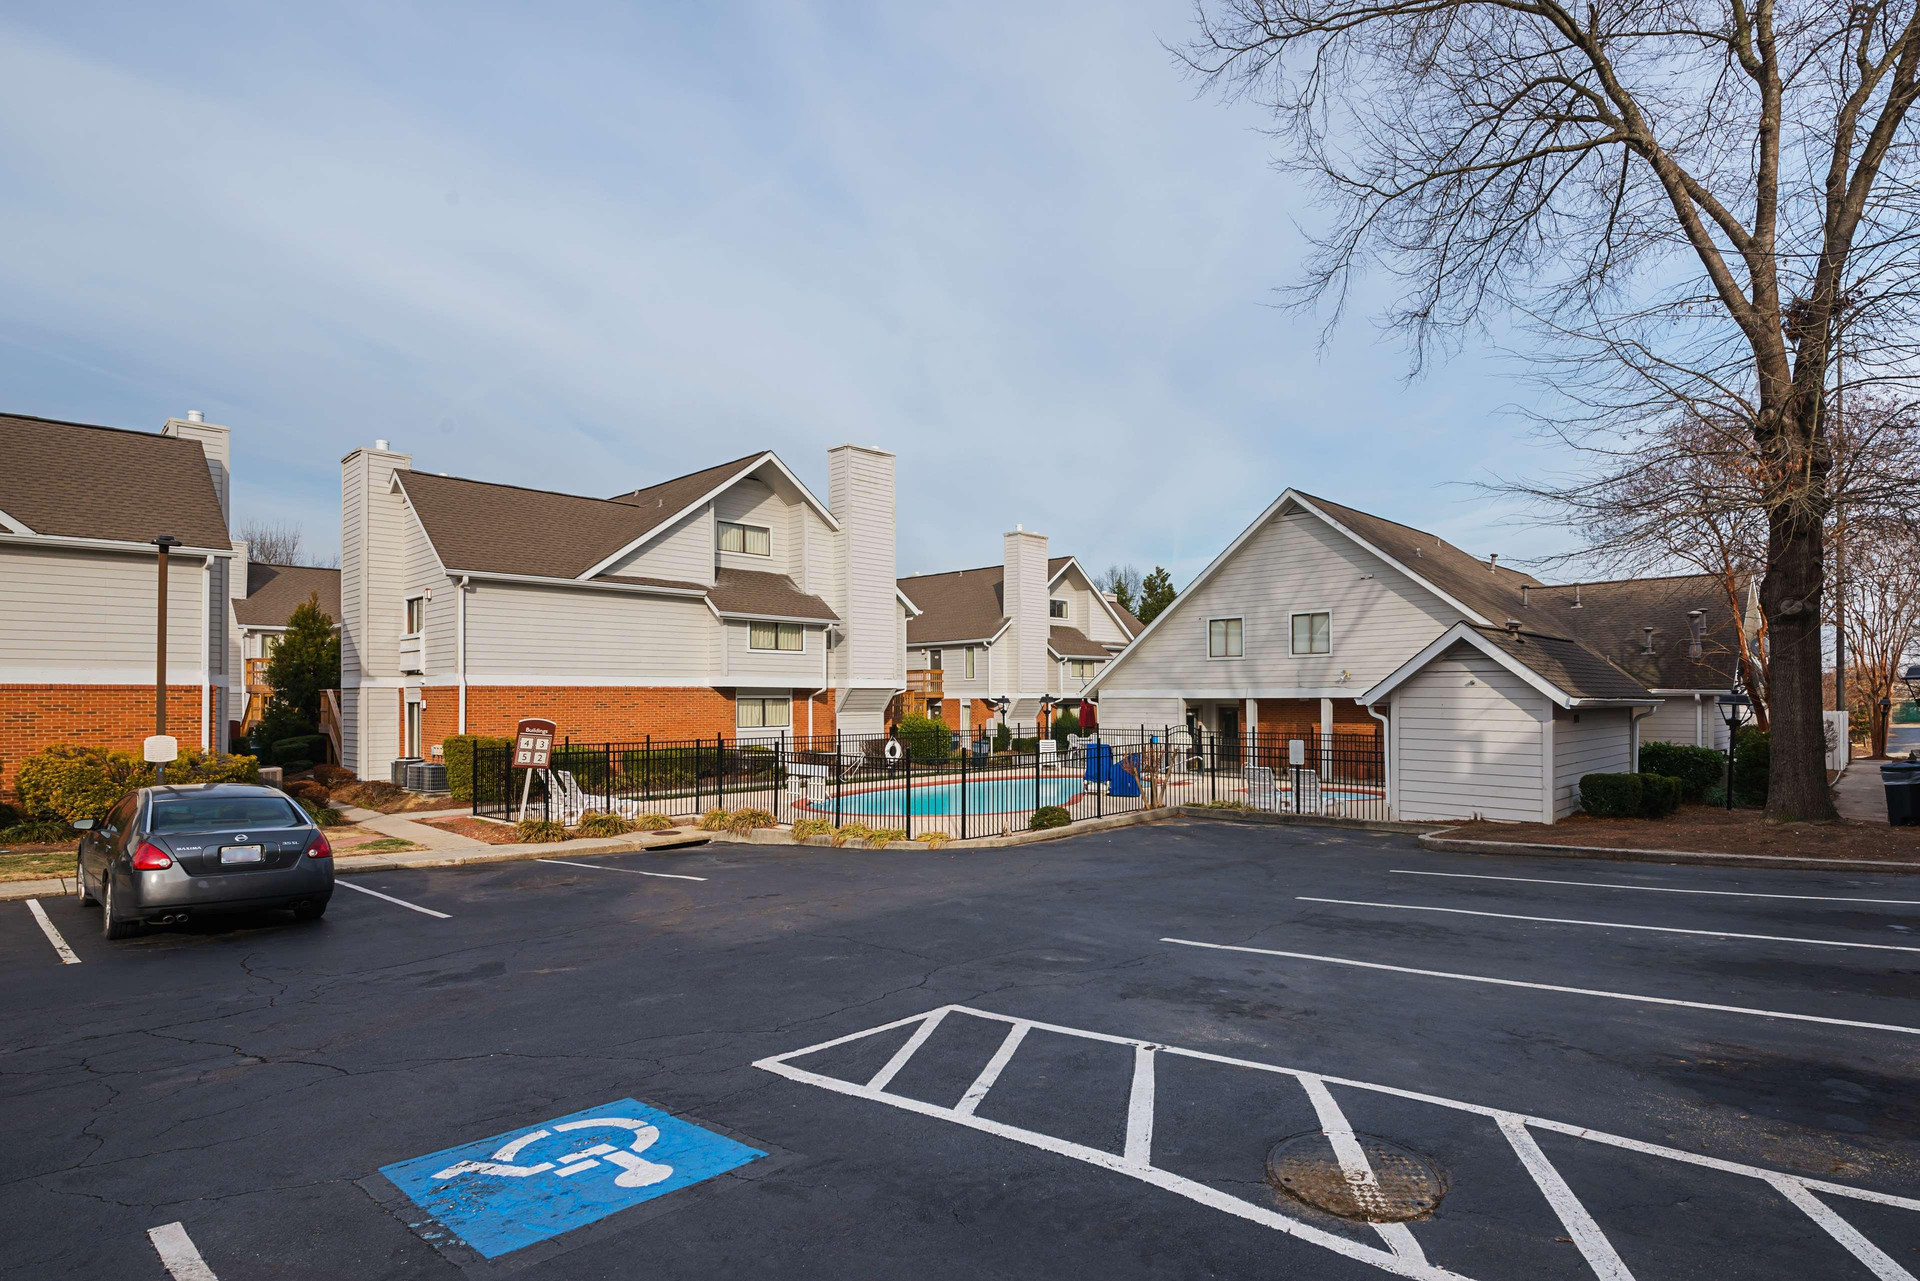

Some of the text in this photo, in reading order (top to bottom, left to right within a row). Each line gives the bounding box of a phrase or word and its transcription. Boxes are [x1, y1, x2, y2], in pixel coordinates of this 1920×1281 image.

[525, 727, 548, 735] Buildings
[539, 740, 545, 748] 3
[521, 753, 543, 762] 5 2
